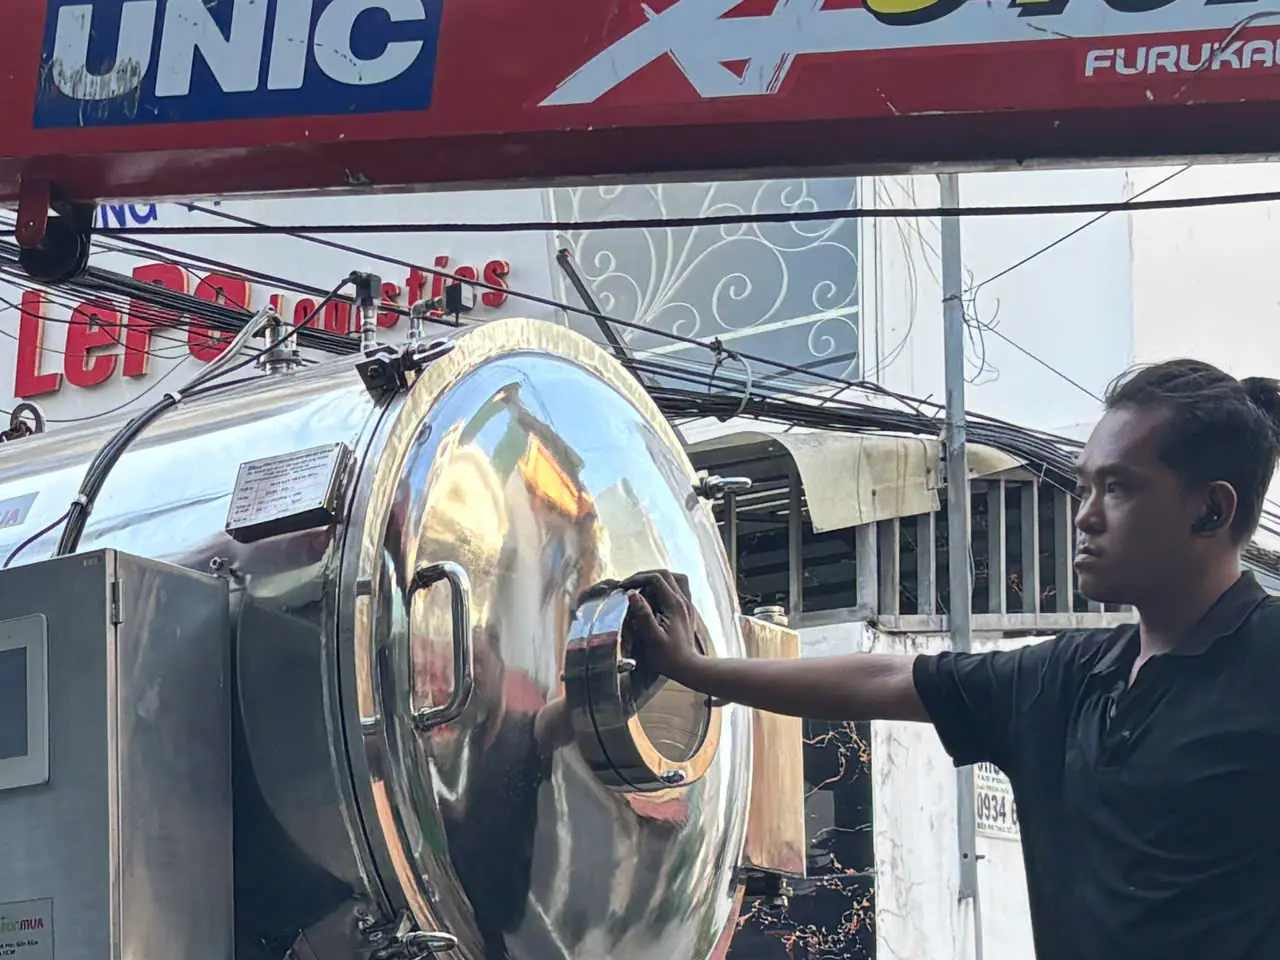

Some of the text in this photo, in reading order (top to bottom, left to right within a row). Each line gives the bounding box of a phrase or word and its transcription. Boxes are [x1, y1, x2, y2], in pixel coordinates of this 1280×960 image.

[51, 0, 426, 100] UNIC
[1085, 39, 1280, 77] FURUKA
[977, 791, 1007, 825] 0934
